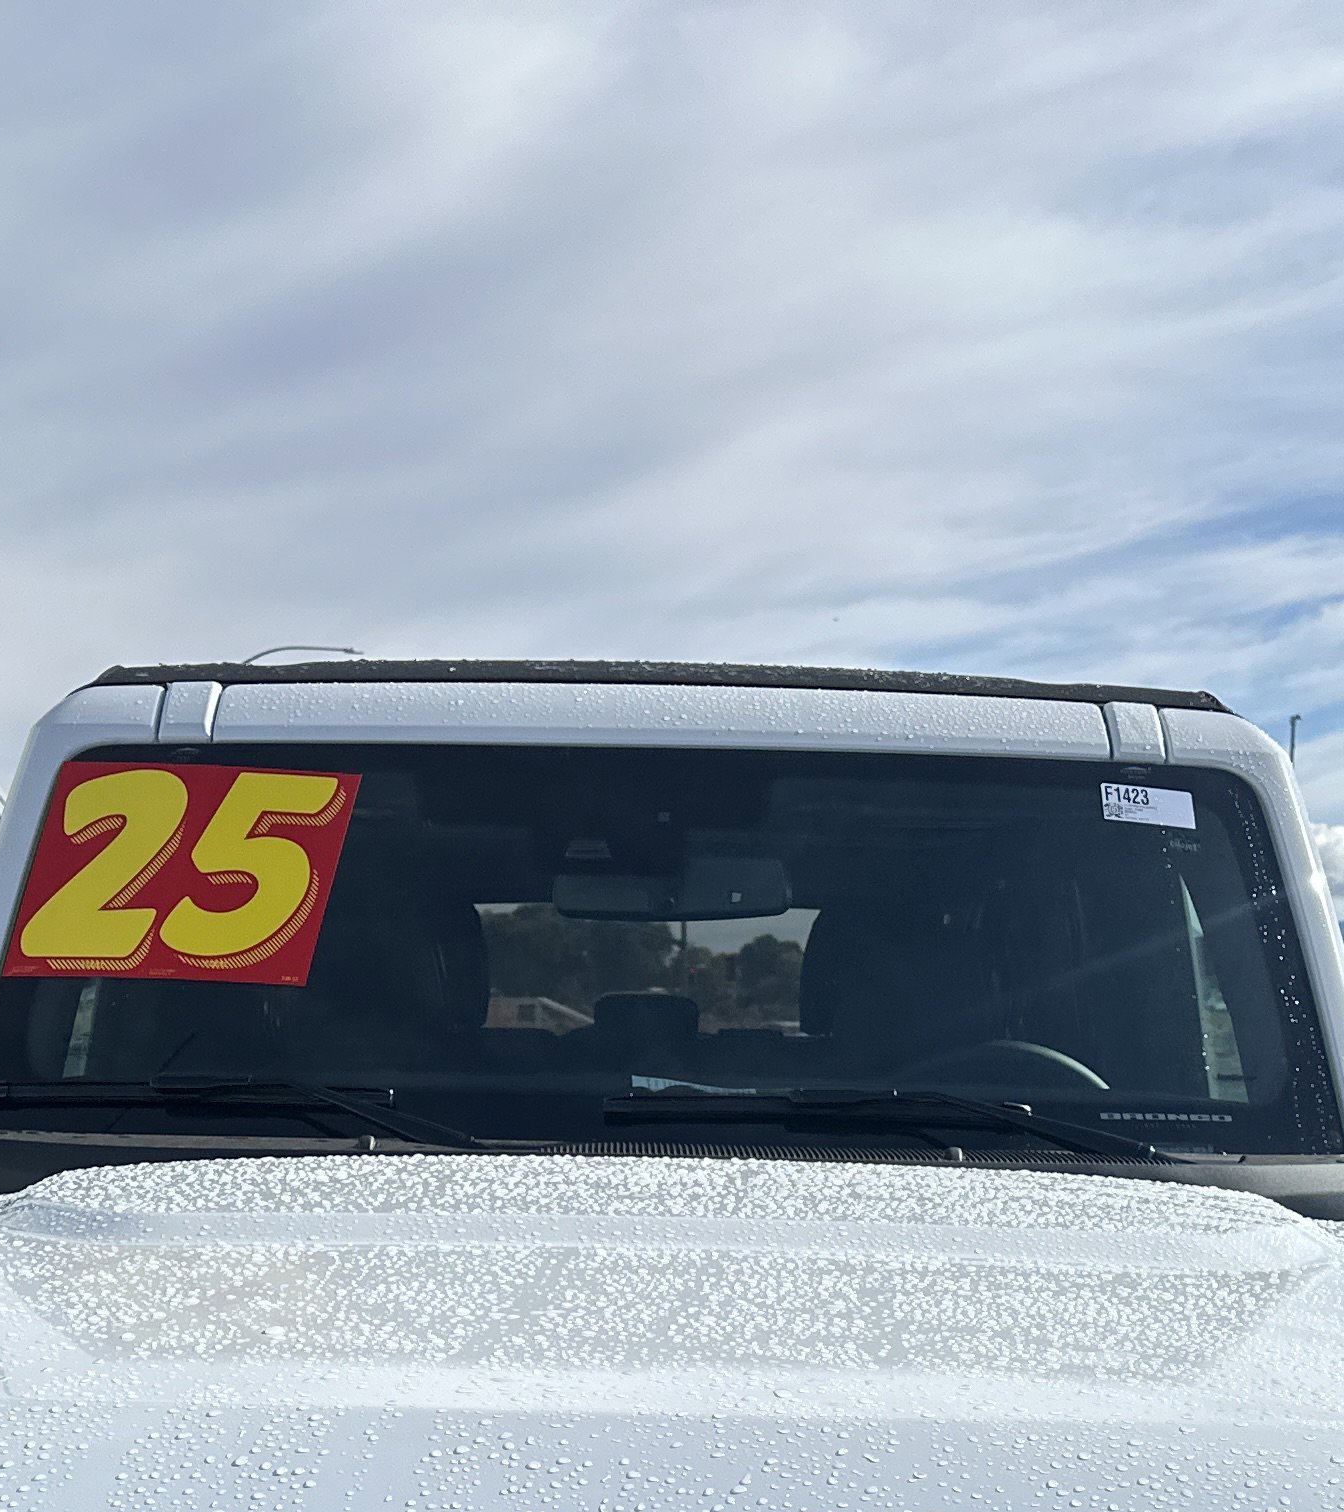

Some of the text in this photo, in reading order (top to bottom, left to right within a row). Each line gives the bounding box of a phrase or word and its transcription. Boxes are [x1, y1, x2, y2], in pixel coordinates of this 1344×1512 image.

[1104, 785, 1150, 806] F1423
[20, 768, 342, 966] 25
[1100, 1112, 1233, 1122] BRONCO
